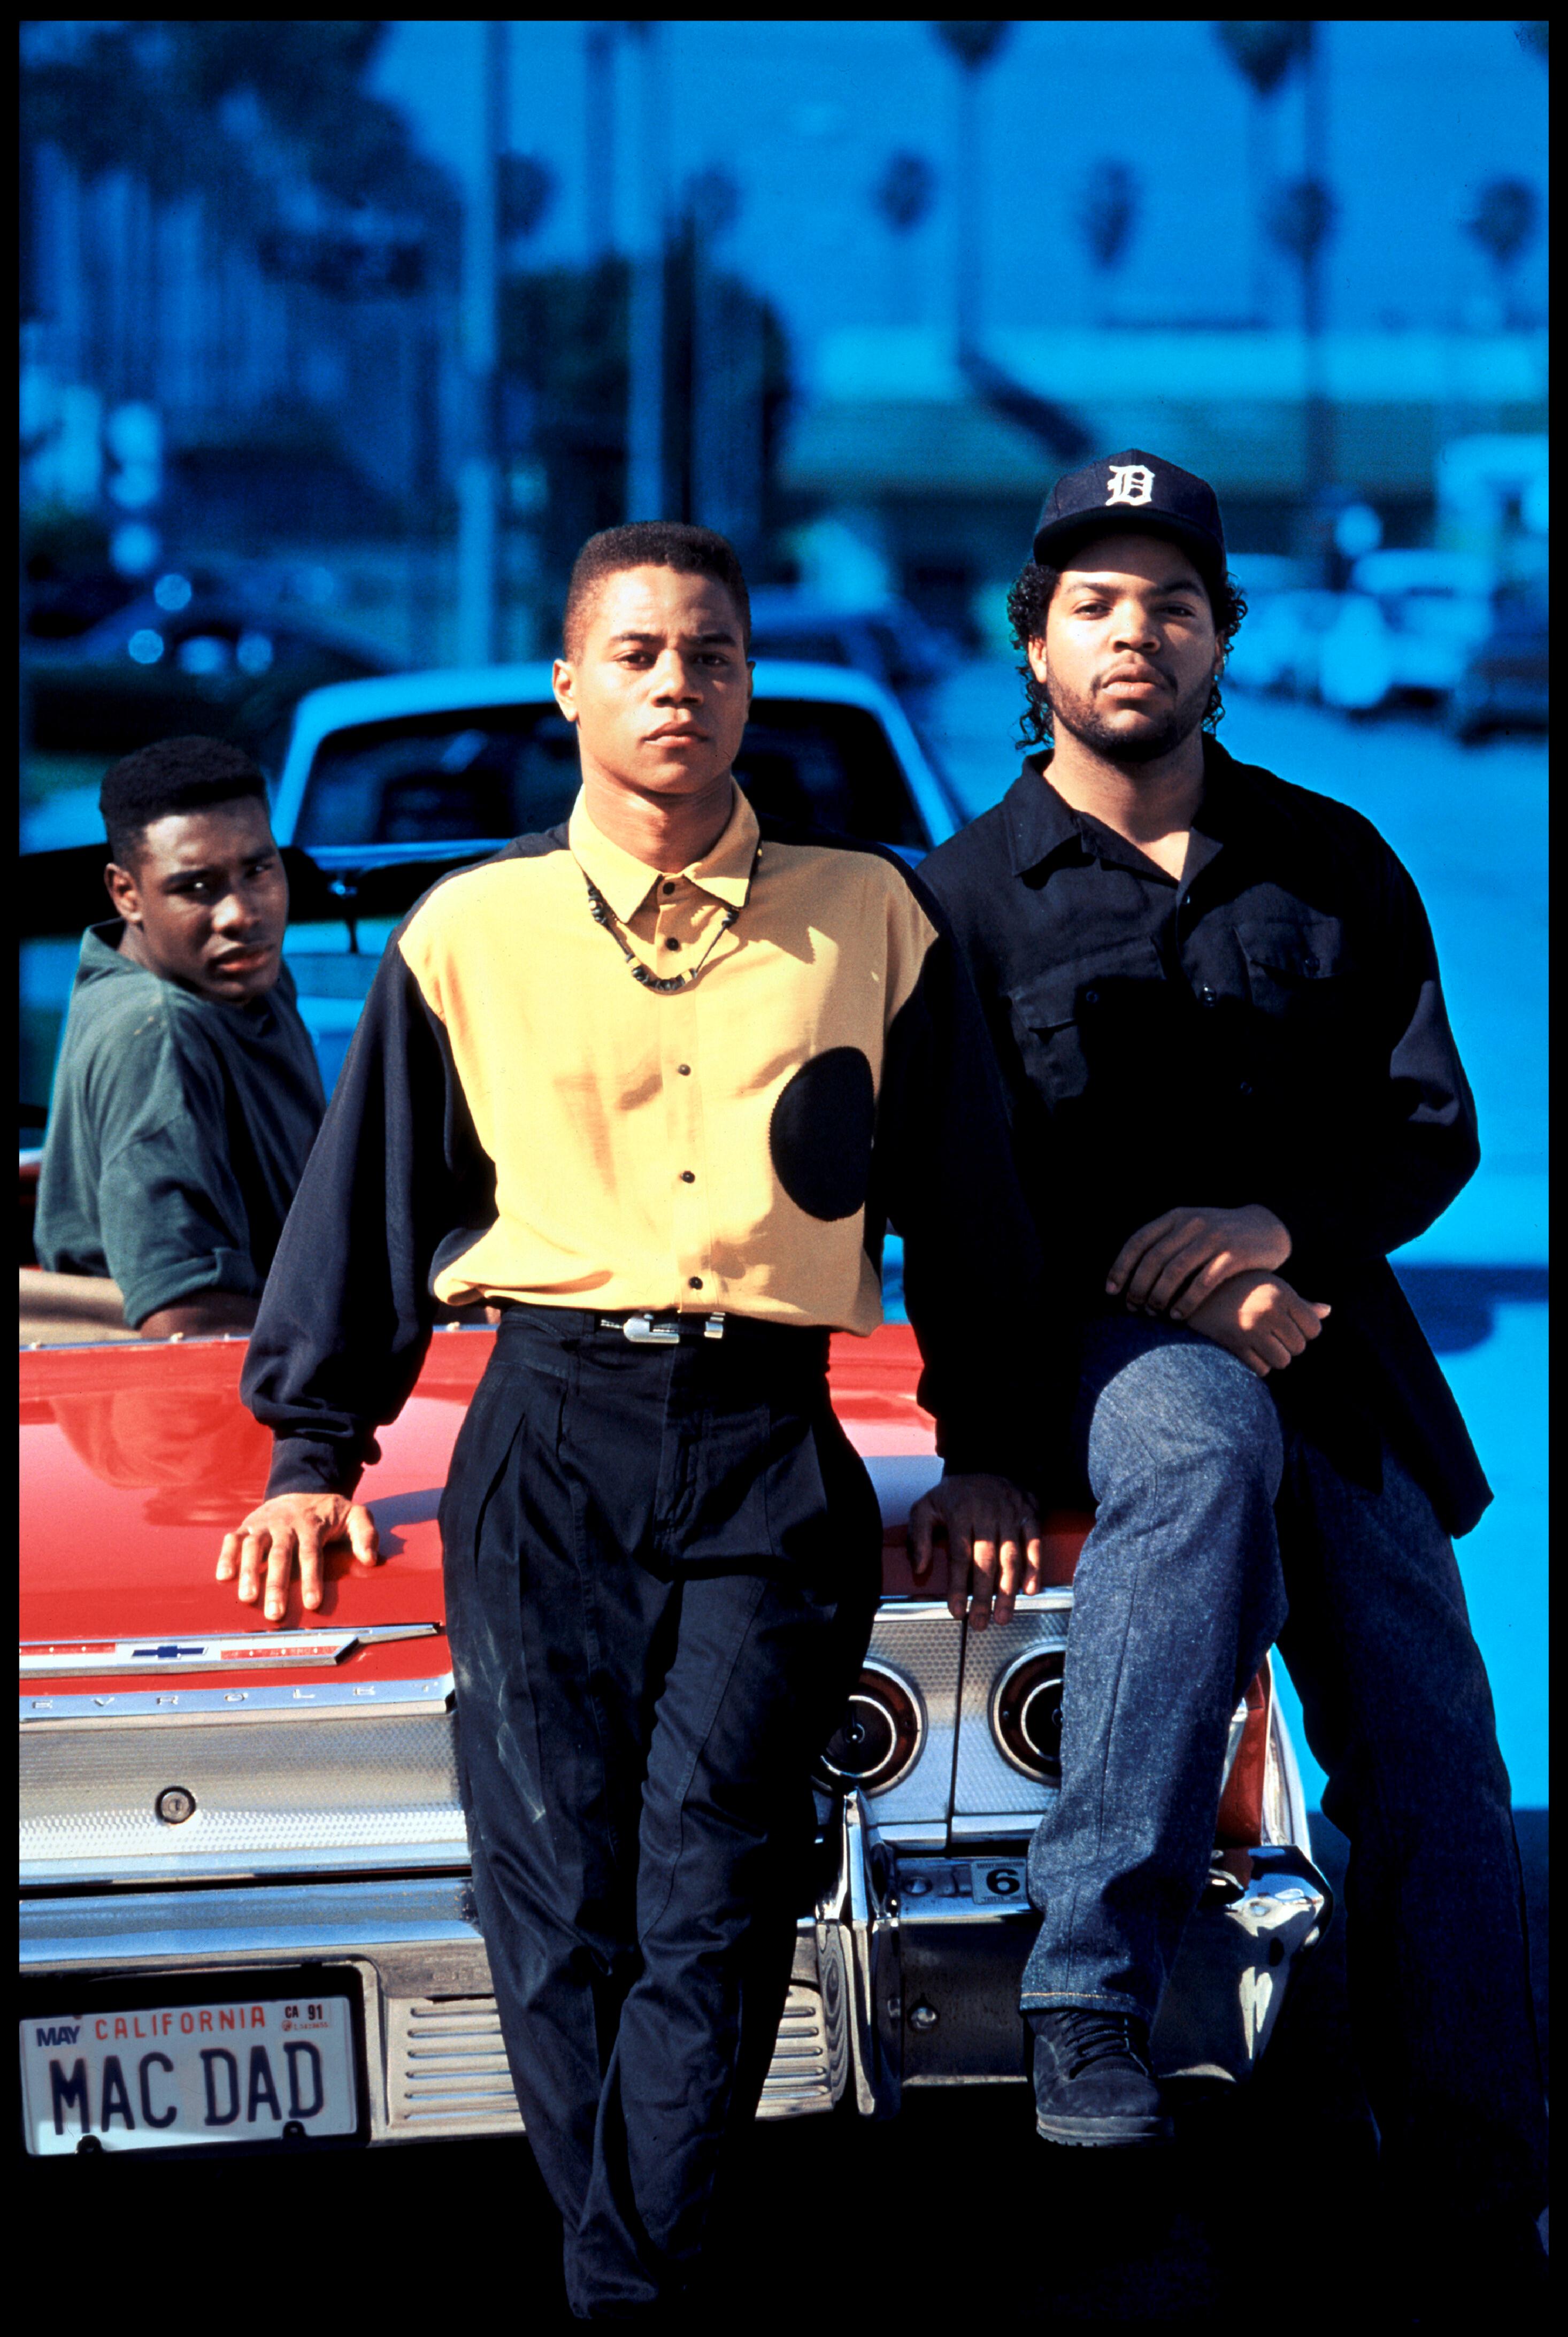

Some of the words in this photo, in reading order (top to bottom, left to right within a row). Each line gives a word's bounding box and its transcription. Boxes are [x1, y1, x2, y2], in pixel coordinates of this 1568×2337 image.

[1105, 465, 1155, 506] D
[986, 1869, 1020, 1895] 6
[95, 2005, 266, 2040] CALIFORNIA
[285, 2005, 299, 2019] CA
[308, 2004, 322, 2020] 91
[36, 2025, 81, 2047] MAY
[49, 2051, 178, 2135] MAC
[199, 2040, 326, 2127] DAD
